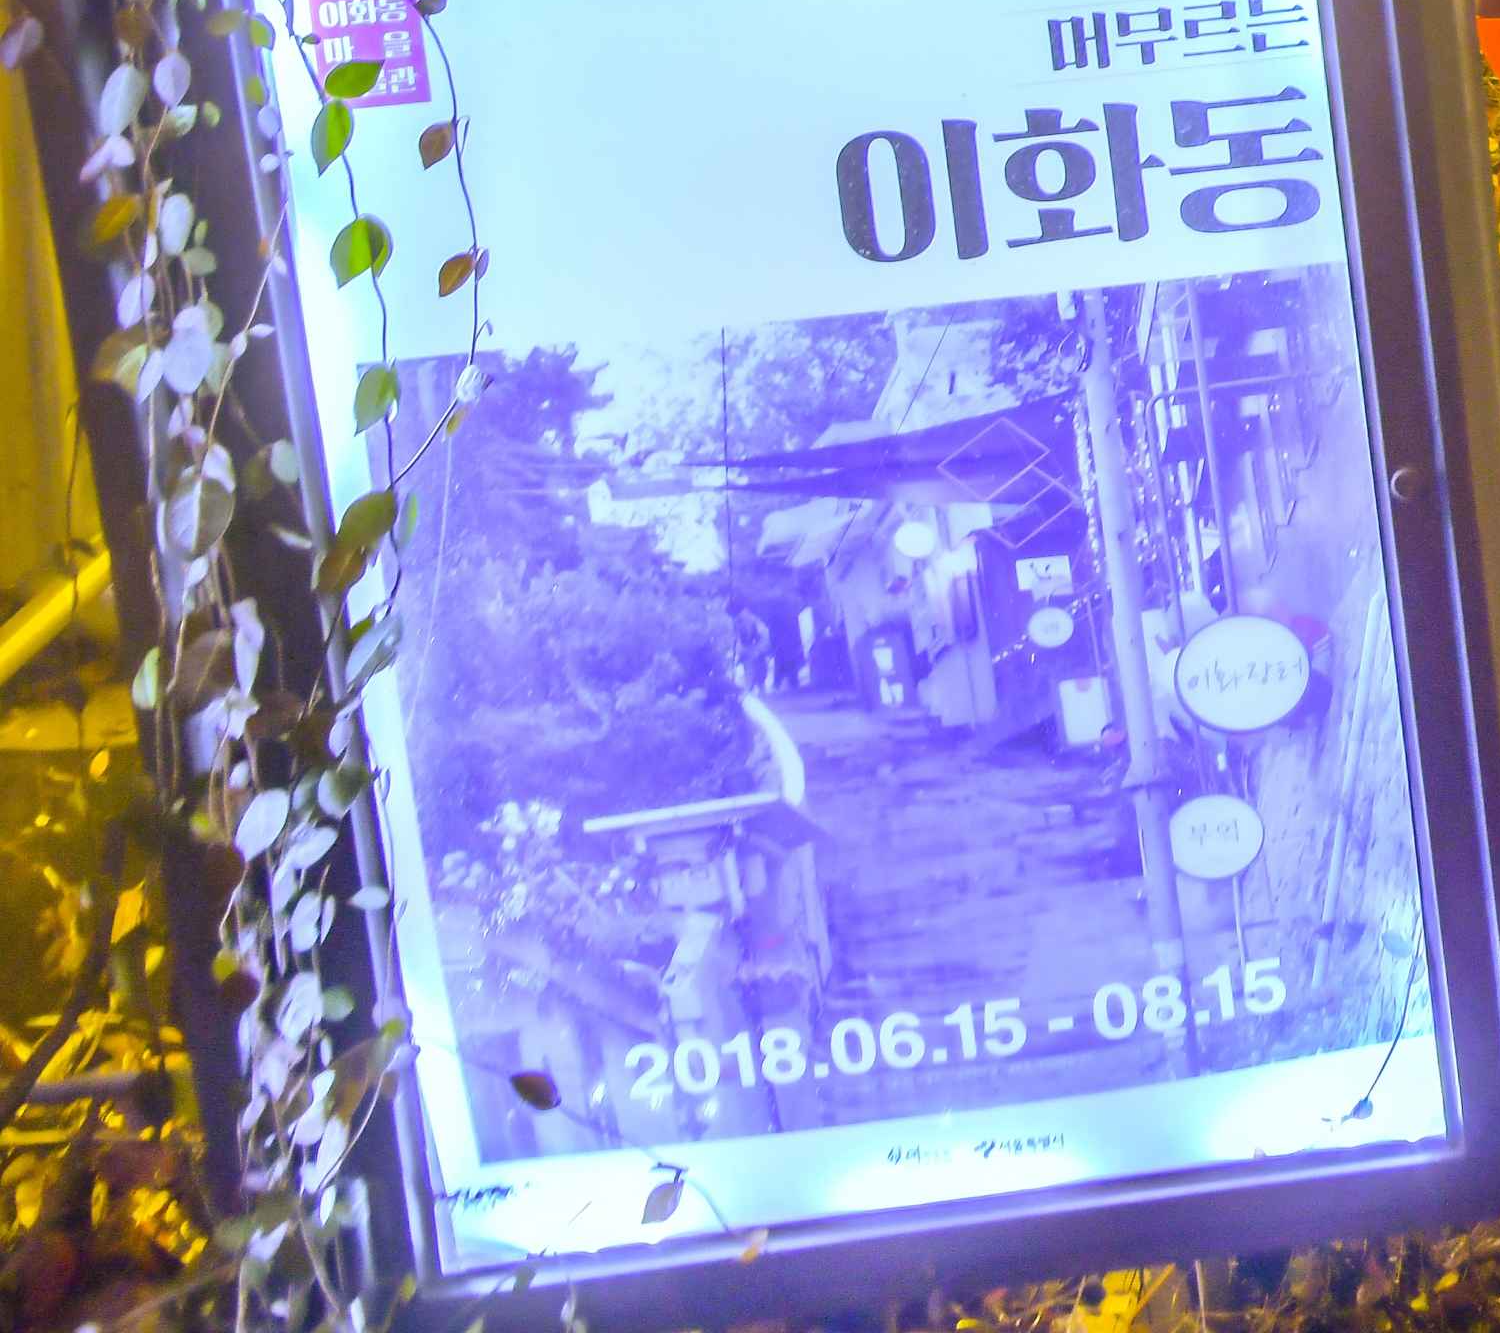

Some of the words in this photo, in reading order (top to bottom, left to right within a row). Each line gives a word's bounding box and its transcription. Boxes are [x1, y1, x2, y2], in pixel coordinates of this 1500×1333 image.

[836, 85, 1324, 263] 이화동
[624, 998, 1028, 1101] 2018.06.15
[1092, 957, 1288, 1041] 08.15
